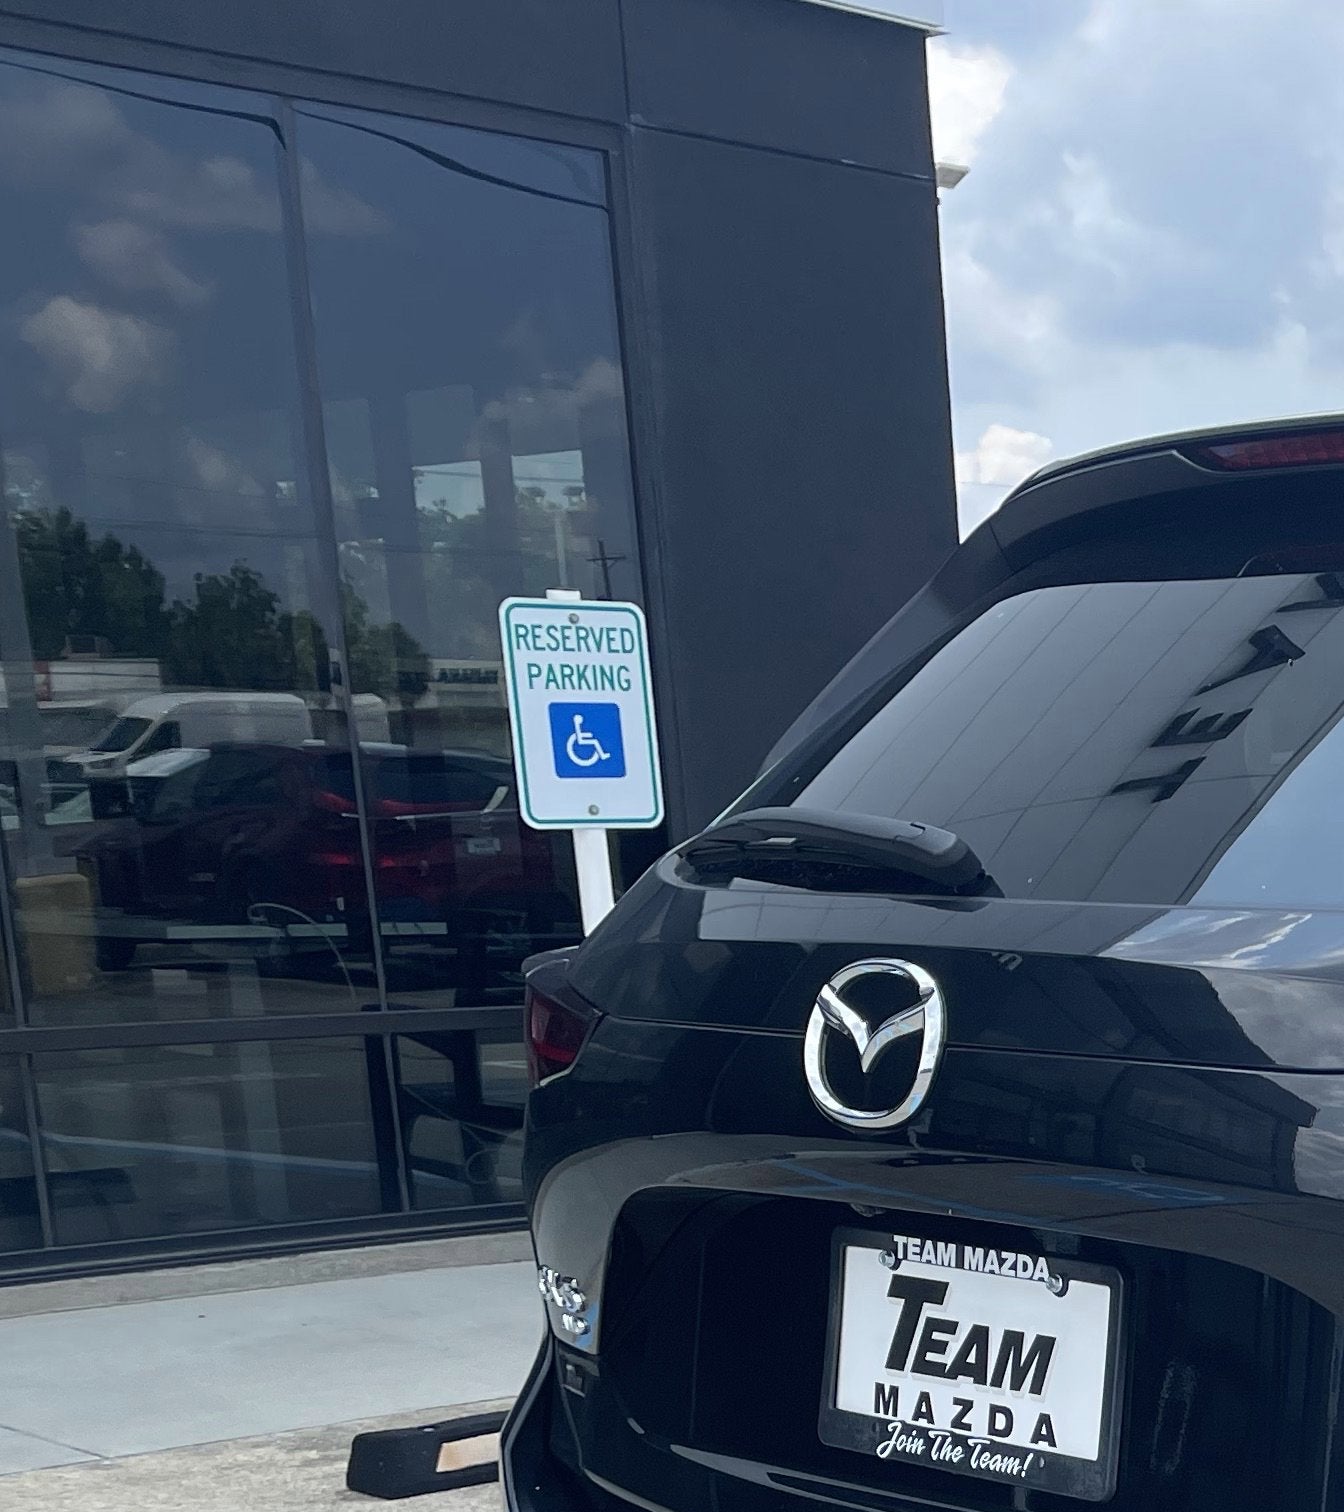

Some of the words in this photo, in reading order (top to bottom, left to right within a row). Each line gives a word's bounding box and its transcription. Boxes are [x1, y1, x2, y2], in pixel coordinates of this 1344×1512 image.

[514, 623, 635, 655] RESERVED
[526, 662, 632, 692] PARKING
[893, 1234, 957, 1267] TEAM
[963, 1246, 1051, 1283] MAZDA
[885, 1273, 1058, 1397] TEAM
[873, 1381, 1058, 1449] MAZDA
[876, 1421, 927, 1459] Join
[928, 1430, 965, 1462] The
[967, 1438, 1034, 1478] Team!
